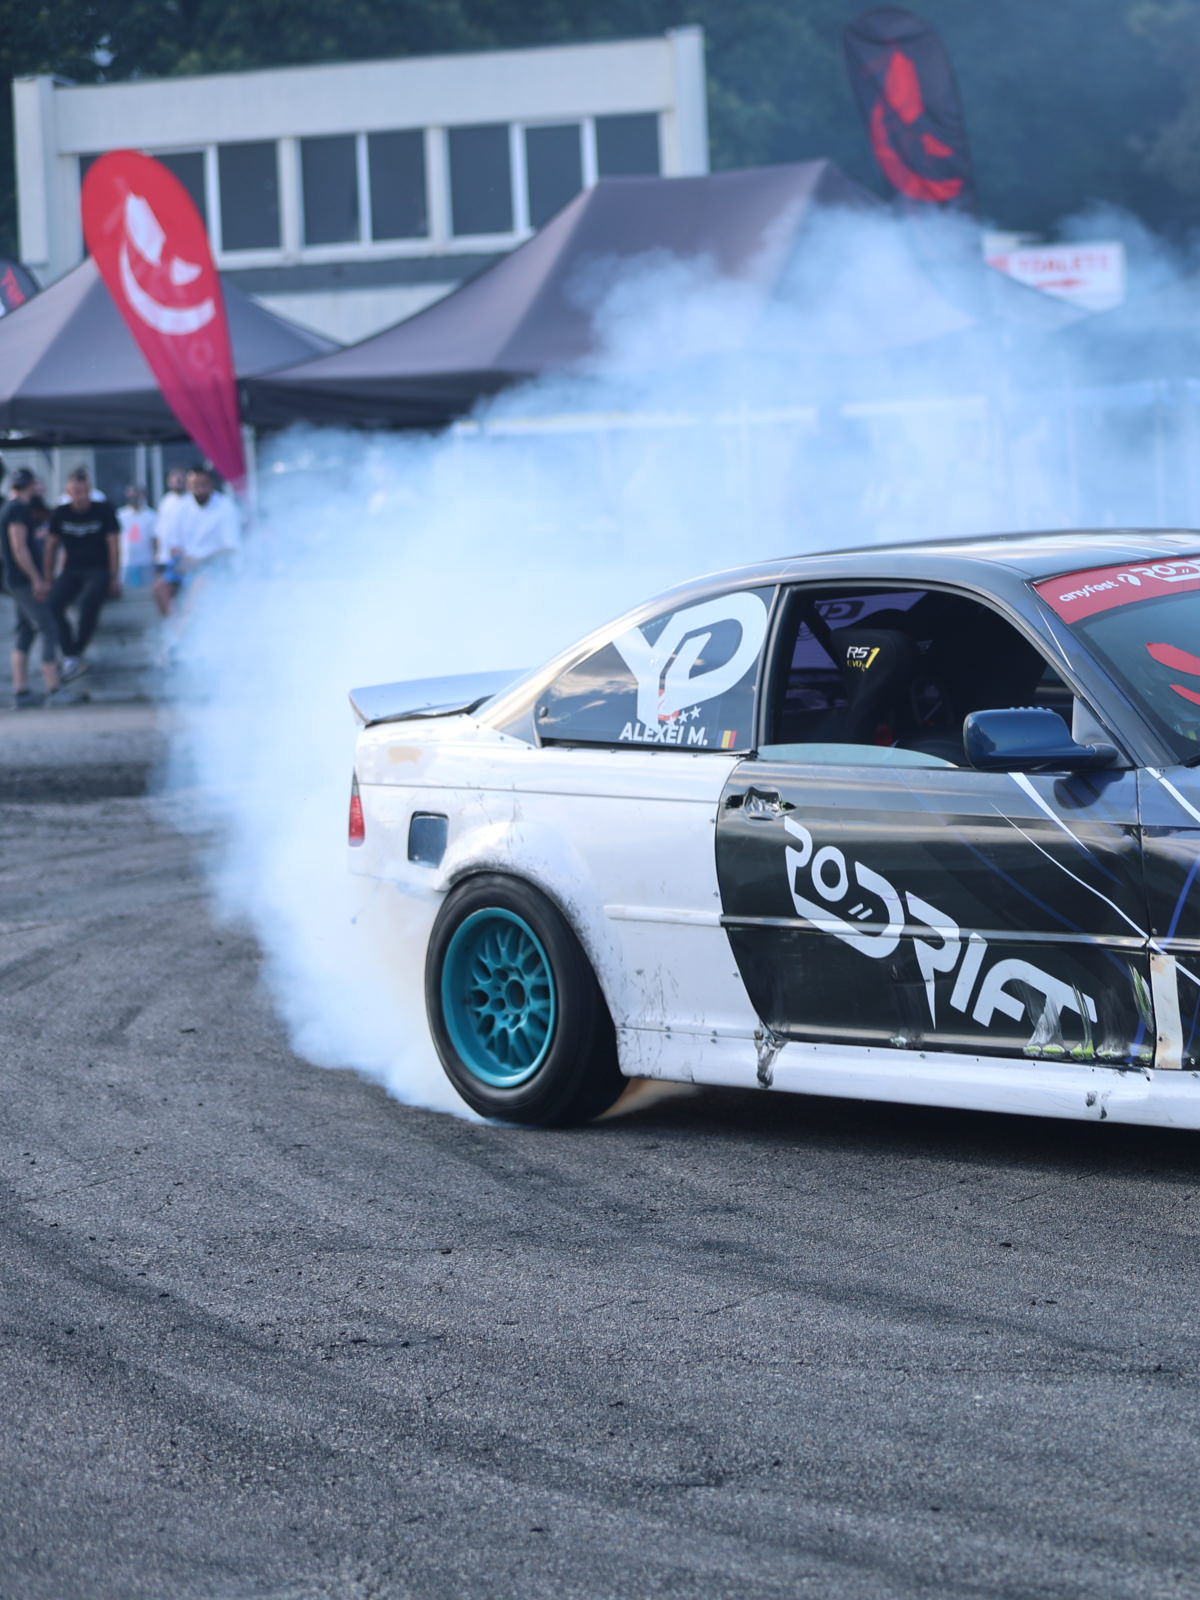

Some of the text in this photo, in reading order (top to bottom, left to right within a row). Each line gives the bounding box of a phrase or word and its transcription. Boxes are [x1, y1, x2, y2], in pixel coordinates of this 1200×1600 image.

[618, 722, 709, 746] ALEXEI M.
[784, 815, 1098, 1040] RODRIFT
